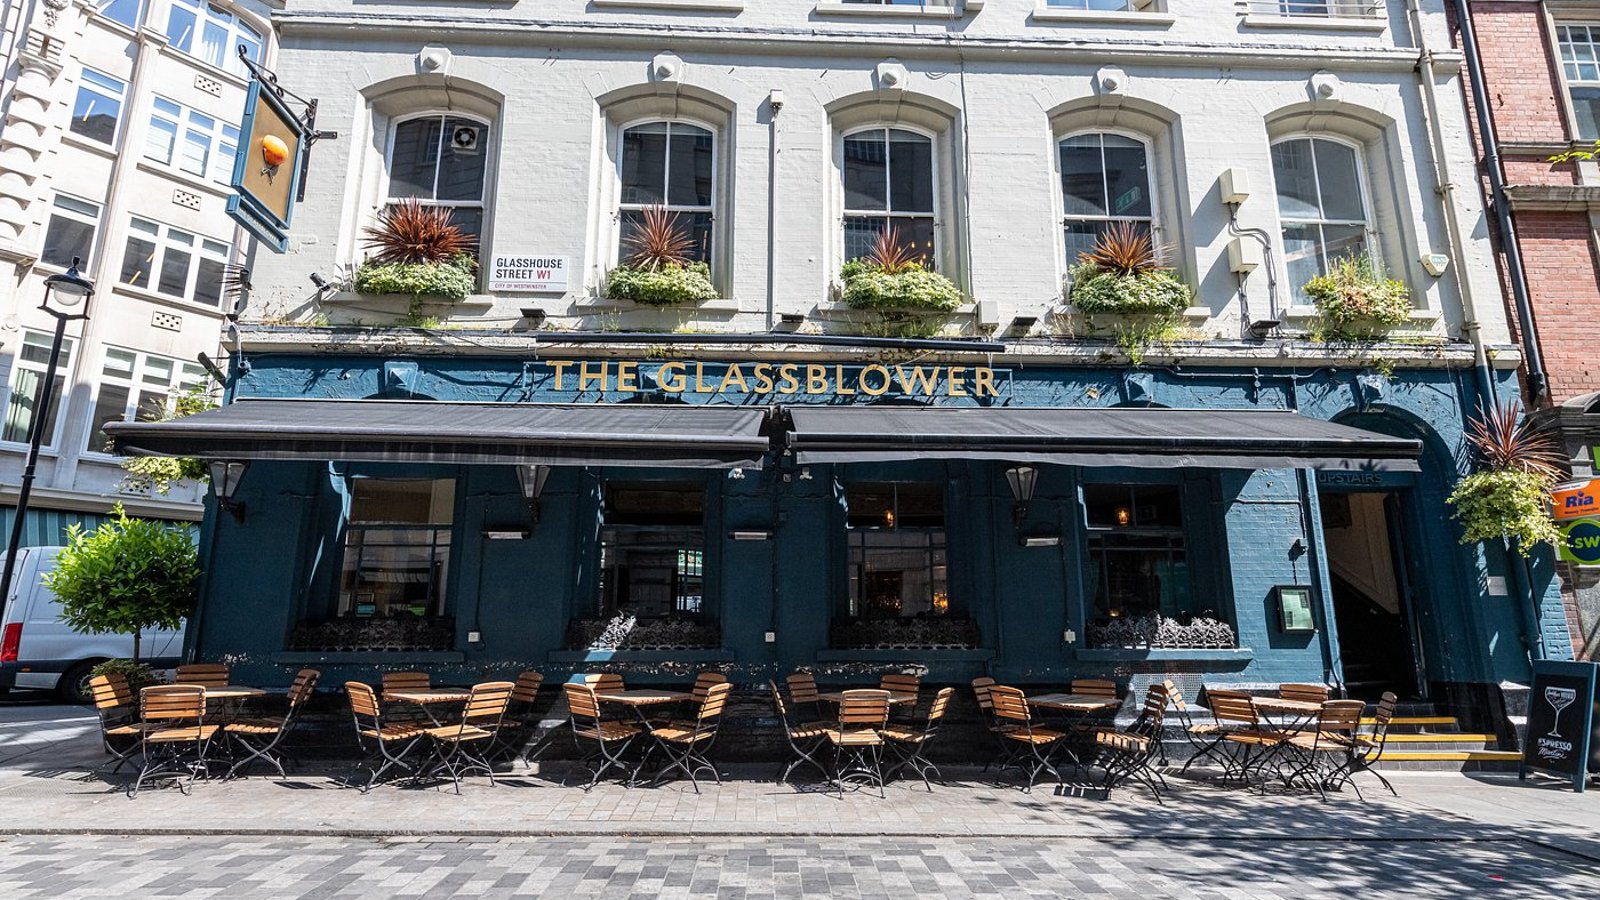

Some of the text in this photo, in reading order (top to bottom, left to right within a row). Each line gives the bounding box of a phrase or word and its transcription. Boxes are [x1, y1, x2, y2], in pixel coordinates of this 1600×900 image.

[496, 257, 563, 269] GLASSHOUSE
[496, 269, 551, 280] STREET W1
[546, 360, 1000, 397] THE GLASSBLOWER
[1319, 472, 1384, 483] UPSTAIRS
[1565, 491, 1594, 508] Ria
